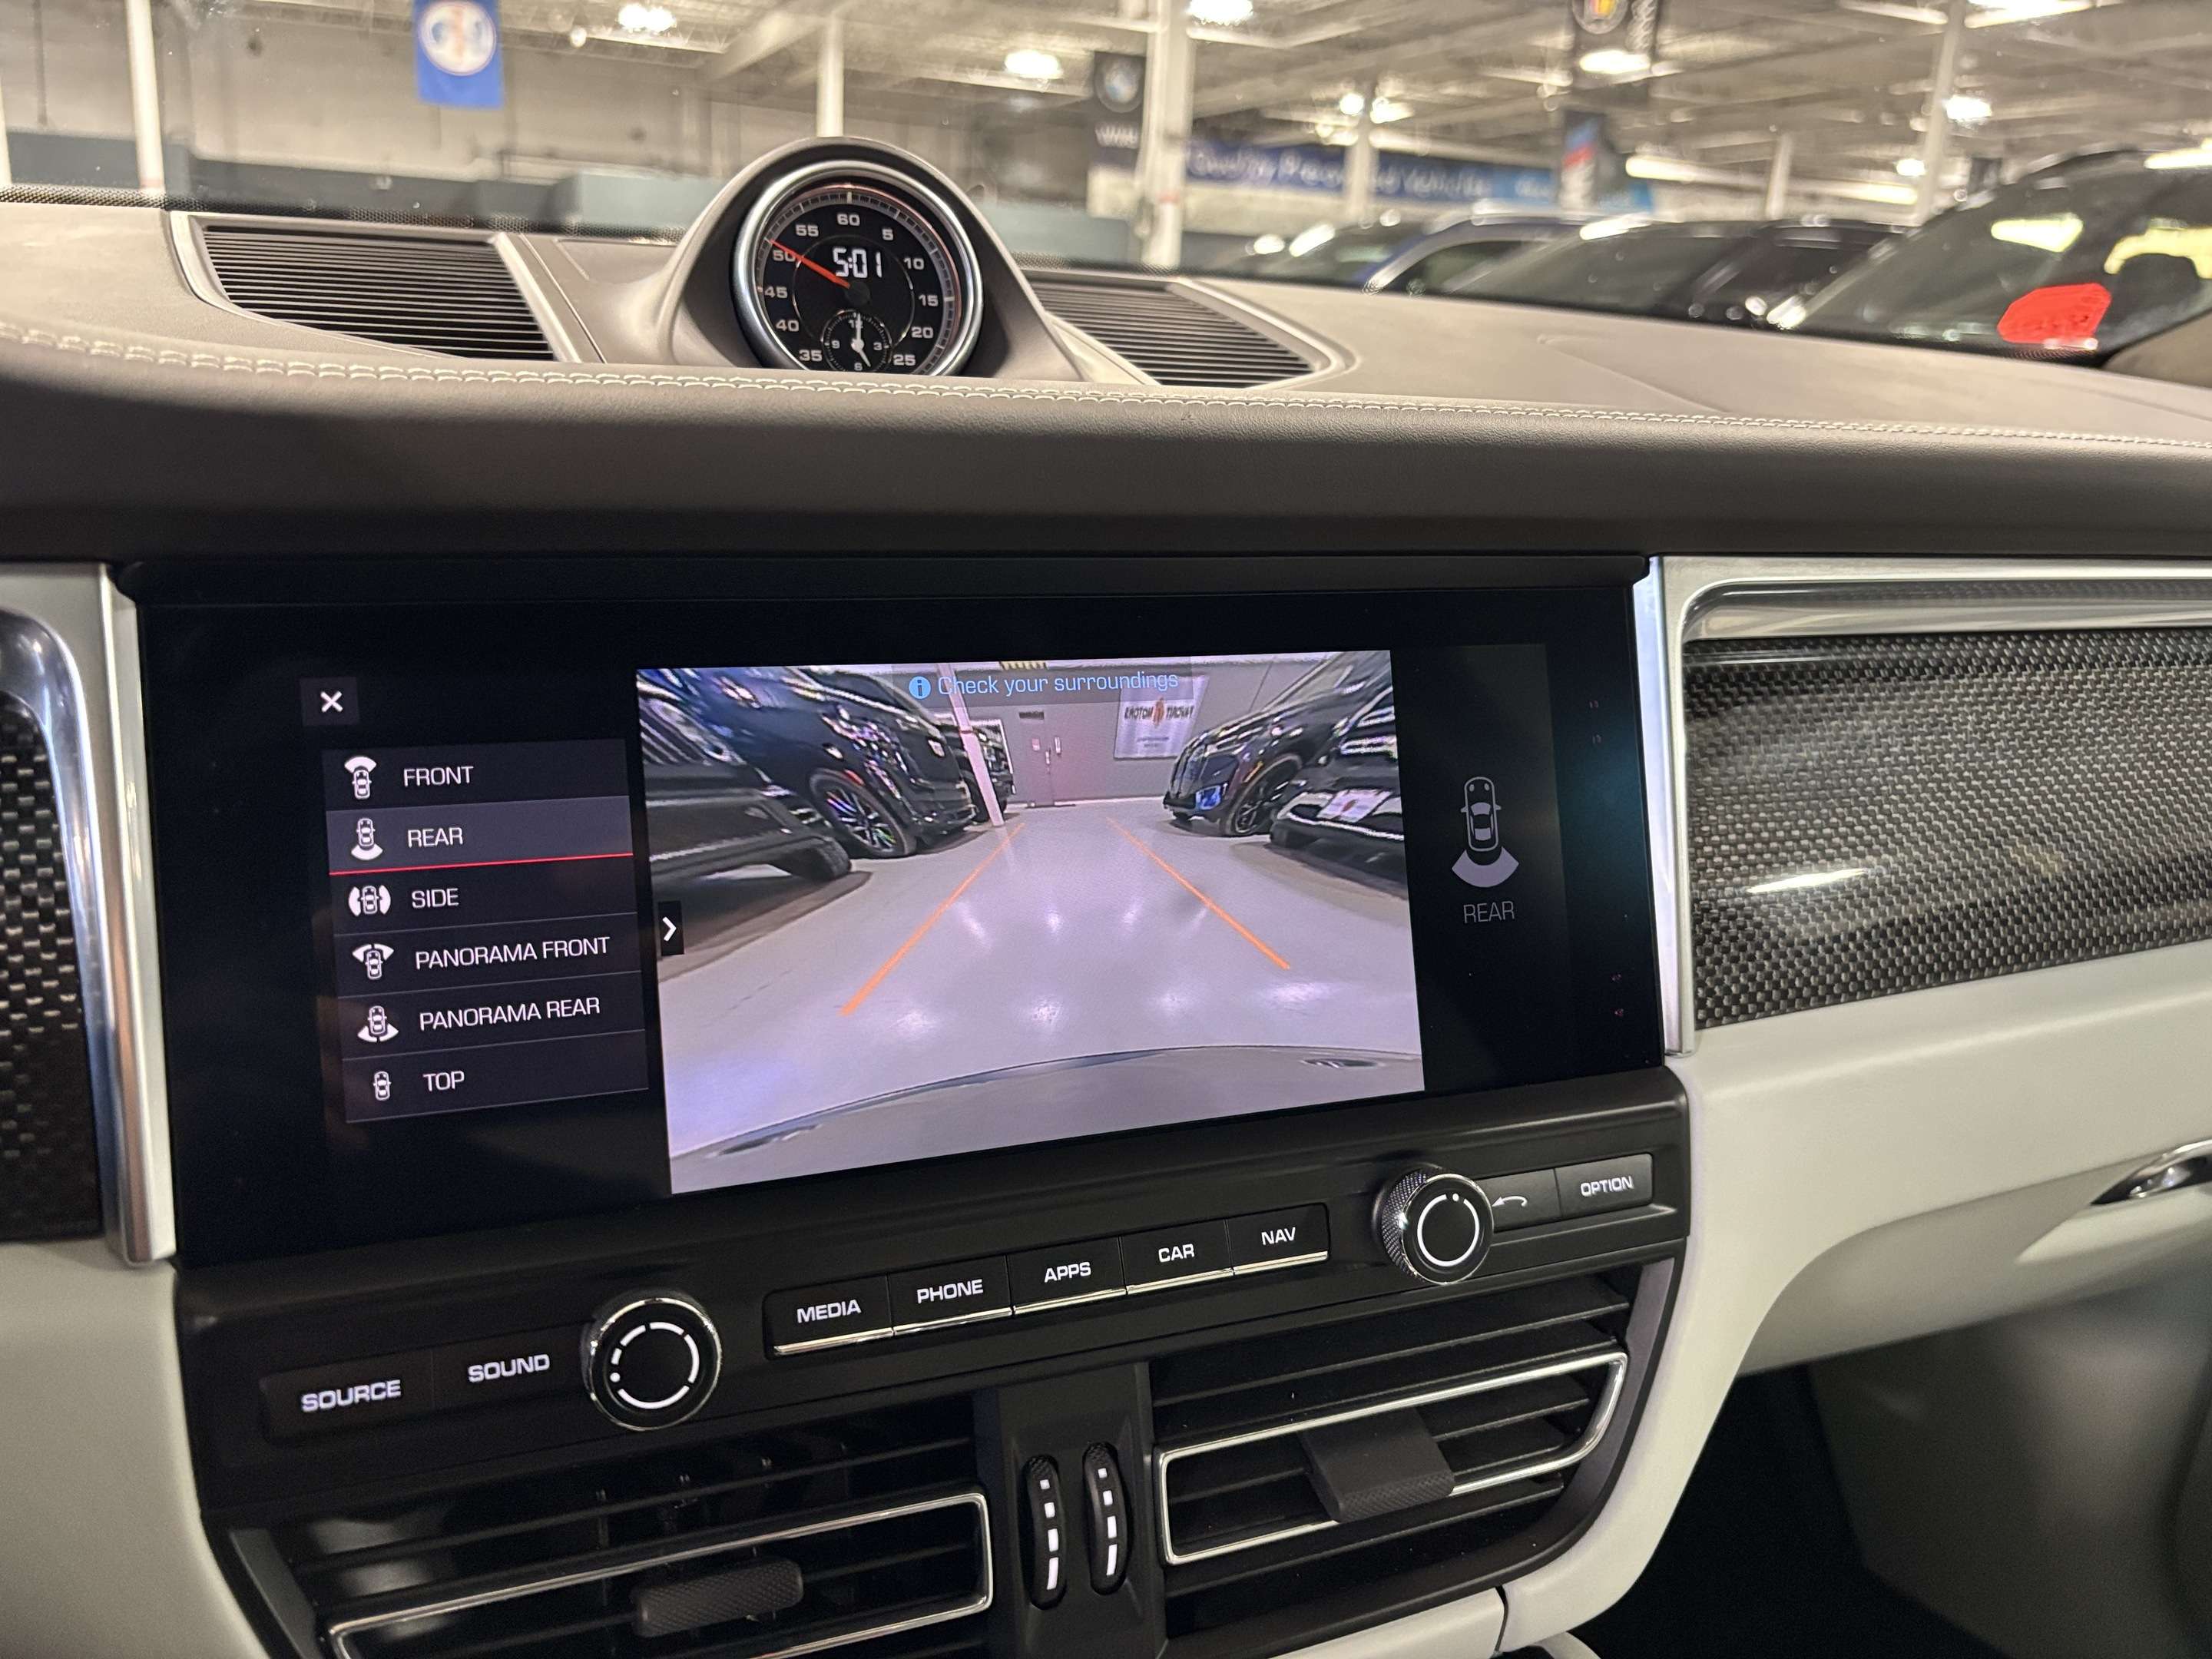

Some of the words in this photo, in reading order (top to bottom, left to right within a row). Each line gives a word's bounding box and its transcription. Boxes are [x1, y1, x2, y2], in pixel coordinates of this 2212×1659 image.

[836, 213, 860, 227] 60
[795, 224, 820, 237] 55
[882, 228, 894, 241] 5
[773, 250, 796, 262] 50
[832, 247, 882, 278] 5:01
[903, 257, 925, 270] 10
[764, 286, 788, 299] 45
[918, 293, 939, 307] 15
[775, 319, 800, 332] 40
[911, 326, 934, 339] 20
[831, 339, 841, 349] 9
[873, 342, 882, 351] 3
[799, 349, 823, 362] 35
[892, 353, 916, 366] 25
[938, 676, 999, 695] Check
[1005, 676, 1049, 697] your
[1054, 671, 1179, 691] surroundings
[403, 766, 474, 787] FRONT
[407, 826, 464, 848] REAR
[411, 888, 459, 909] SIDE
[1463, 900, 1515, 924] REAR
[416, 942, 538, 970] PANORAMA
[542, 936, 611, 959] FRONT
[419, 1002, 542, 1031] PANORAMA
[546, 997, 601, 1018] REAR
[422, 1070, 465, 1091] TOP
[1580, 1175, 1634, 1197] OPTION
[1261, 1227, 1296, 1246] NAV
[1158, 1243, 1195, 1263] CAR
[1044, 1261, 1091, 1283] APPS
[916, 1279, 984, 1304] PHONE
[796, 1299, 862, 1323] MEDIA
[468, 1353, 550, 1383] SOUND
[301, 1379, 402, 1412] SOURCE
